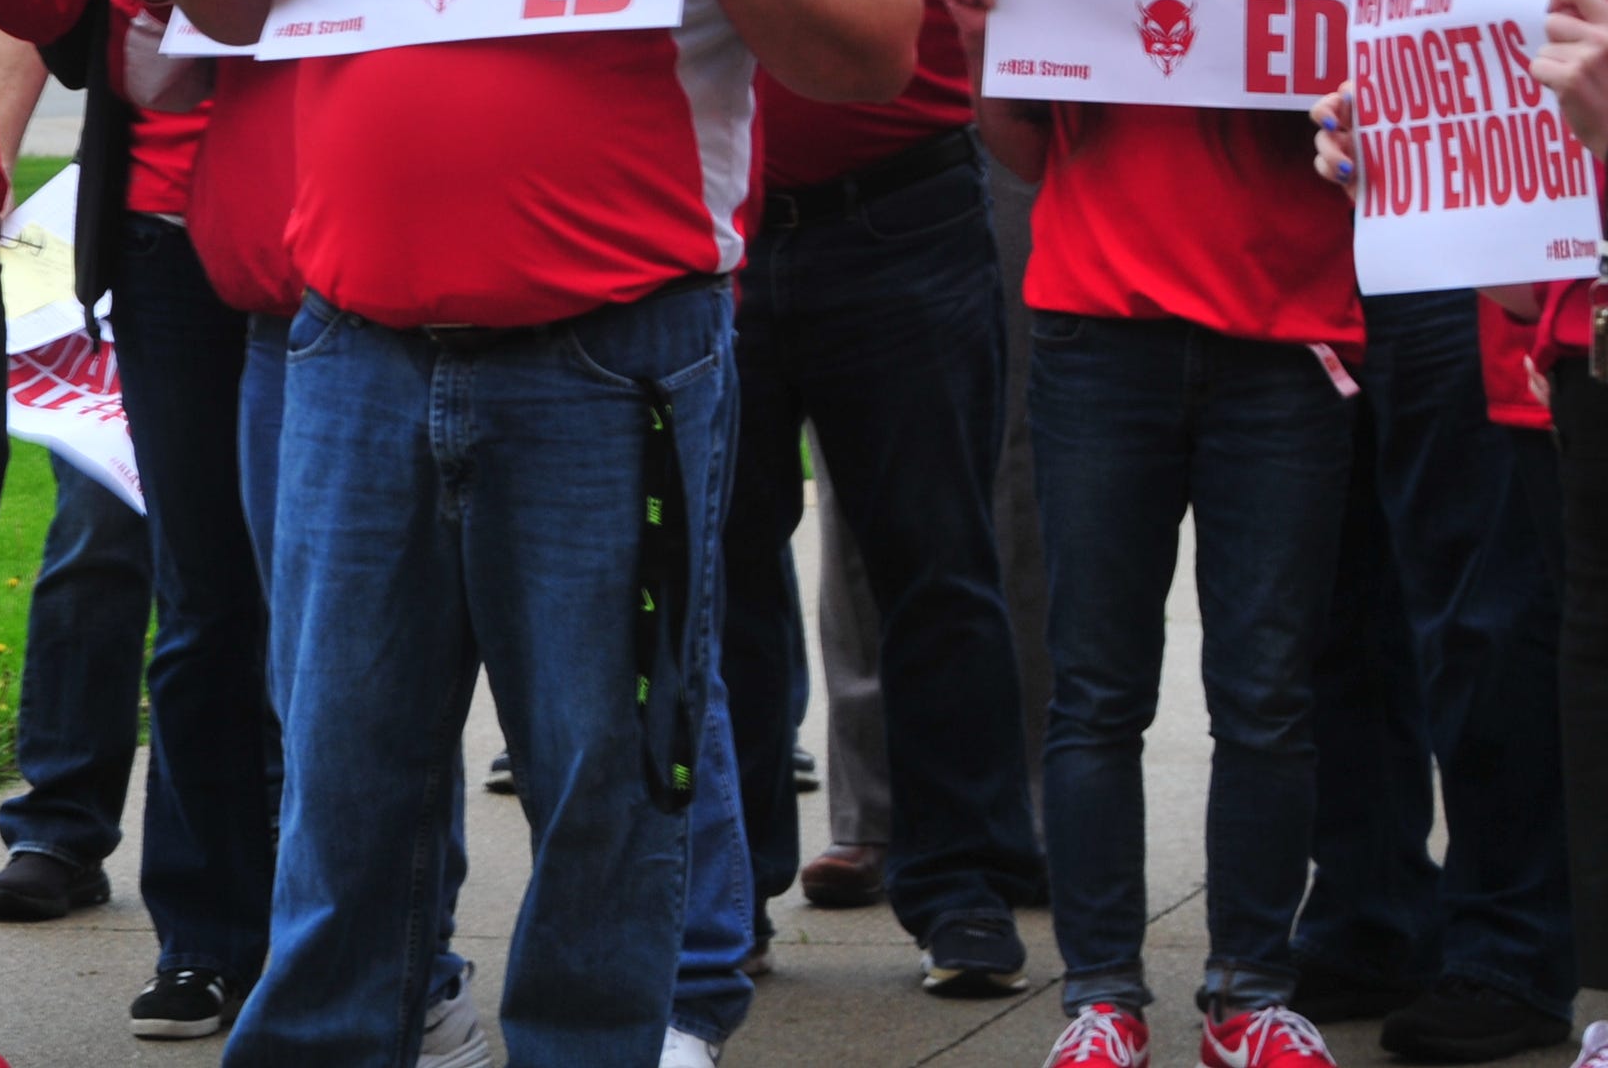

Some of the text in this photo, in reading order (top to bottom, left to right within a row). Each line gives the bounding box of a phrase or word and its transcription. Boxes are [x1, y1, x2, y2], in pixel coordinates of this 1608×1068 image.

[1039, 60, 1090, 80] Strong
[1356, 19, 1541, 126] BUDGET IS
[1362, 126, 1429, 218] NOT
